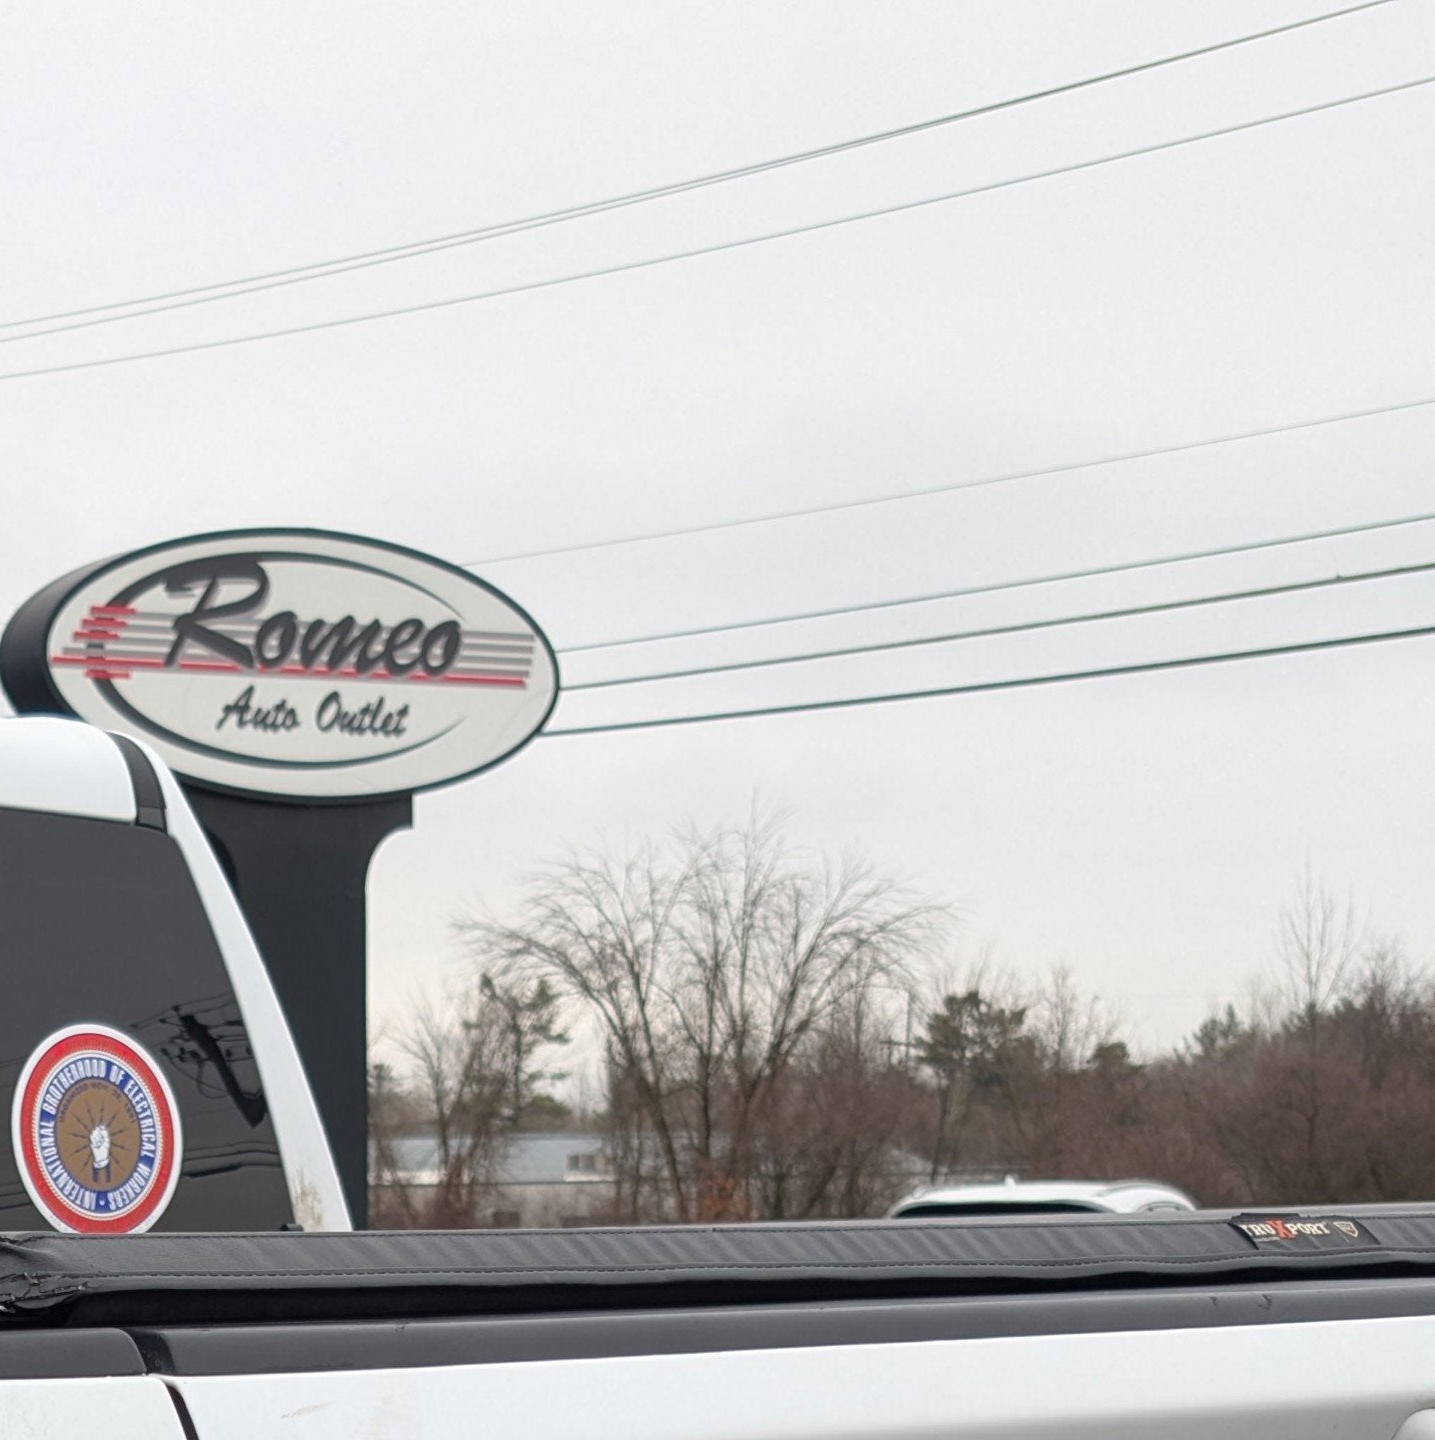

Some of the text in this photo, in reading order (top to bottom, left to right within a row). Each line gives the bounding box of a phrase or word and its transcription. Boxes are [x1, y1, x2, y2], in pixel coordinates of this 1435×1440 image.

[163, 556, 464, 677] Romeo
[215, 685, 410, 737] Auto Outlet
[39, 1059, 156, 1211] INTERNATIONAL BROTHERHOOD OF ELECTRICAL WORKERS
